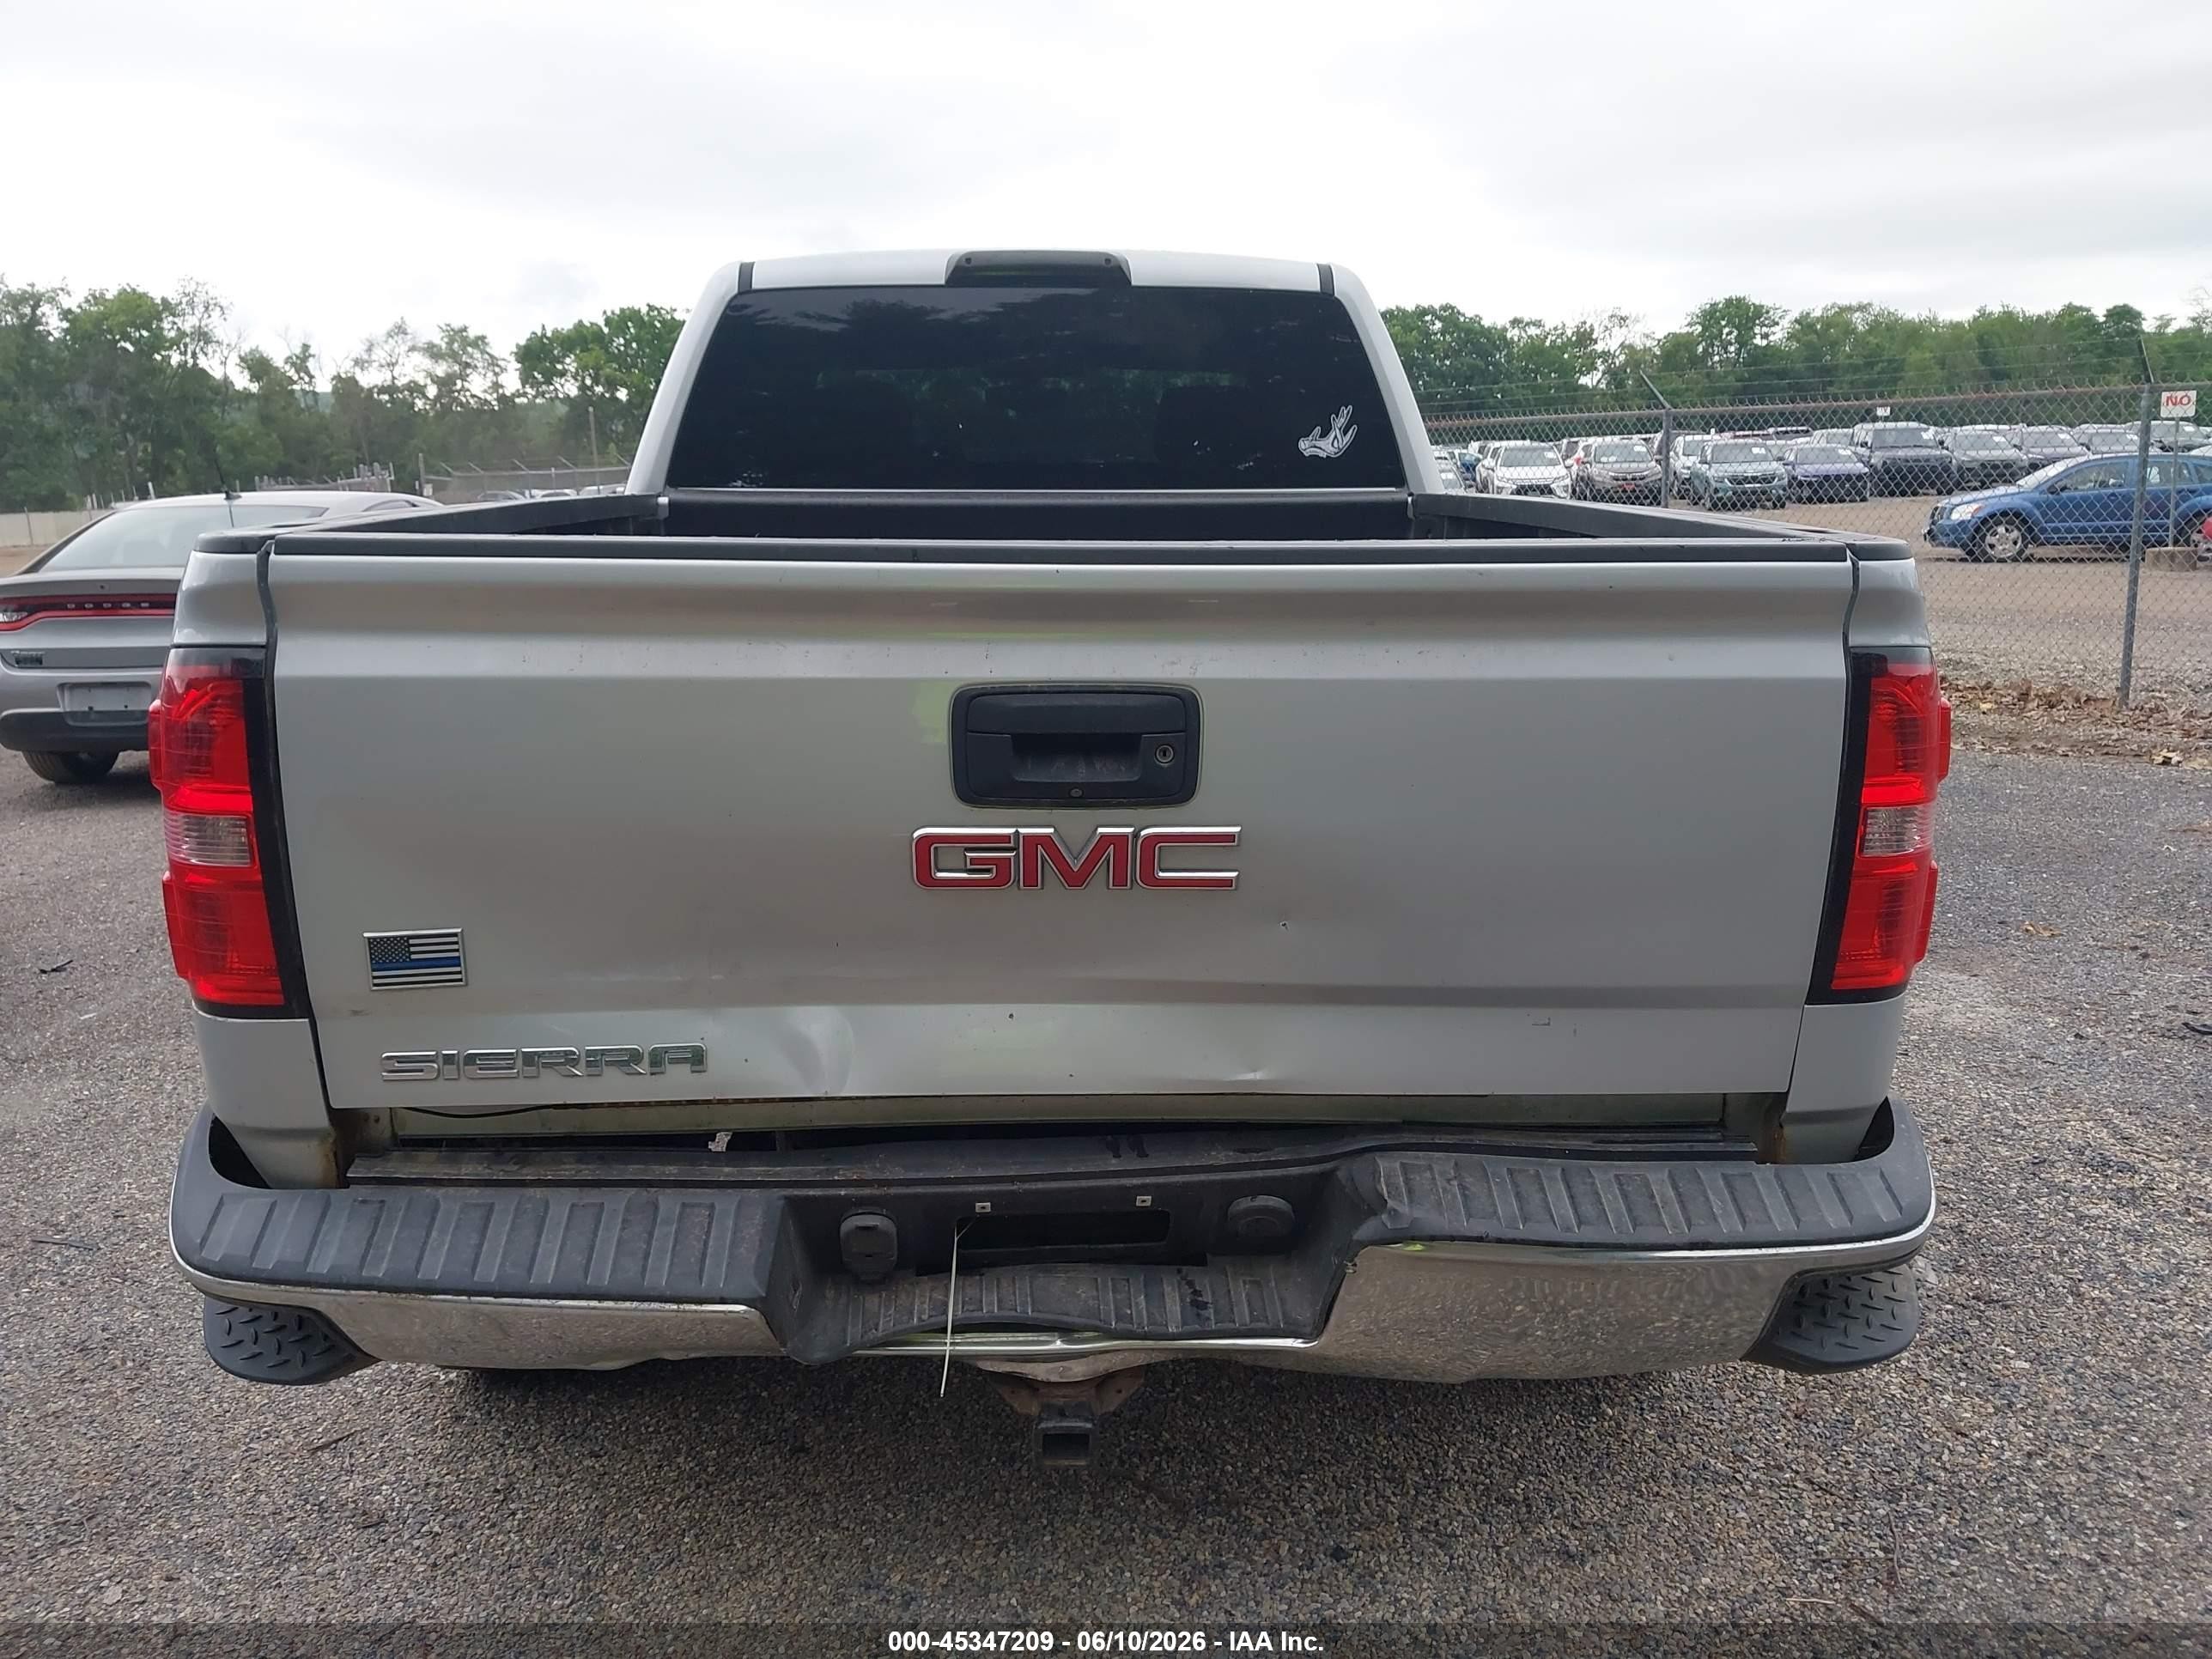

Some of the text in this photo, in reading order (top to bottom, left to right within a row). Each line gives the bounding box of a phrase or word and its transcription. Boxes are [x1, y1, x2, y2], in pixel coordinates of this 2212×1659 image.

[2166, 395, 2191, 406] NO
[912, 826, 1242, 890] GMC
[381, 1042, 708, 1080] SIERRA
